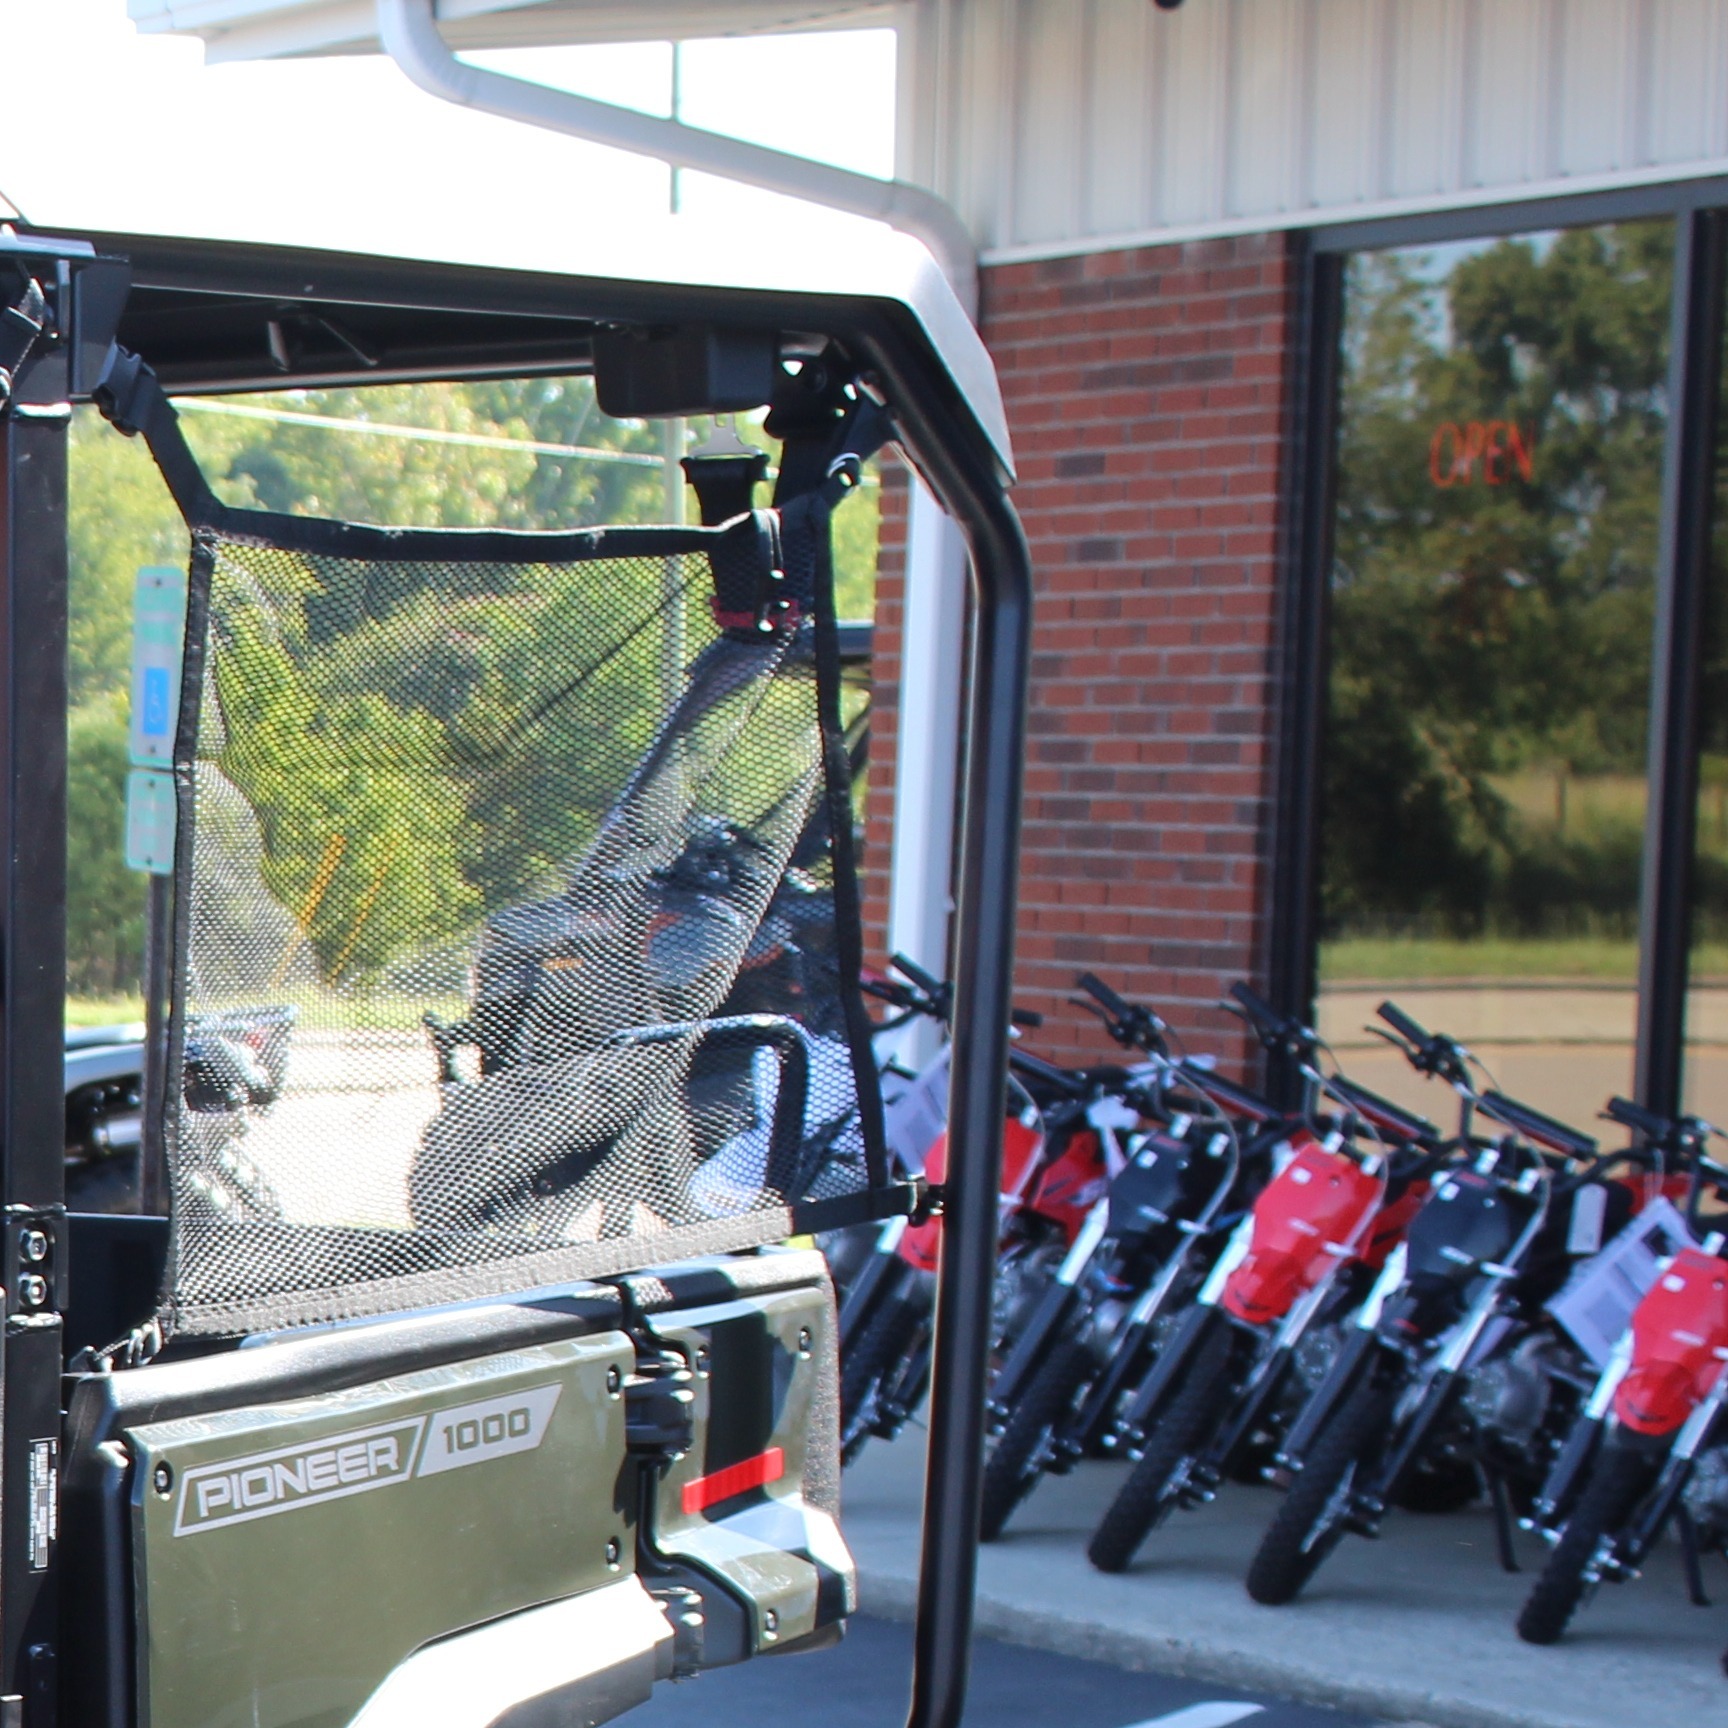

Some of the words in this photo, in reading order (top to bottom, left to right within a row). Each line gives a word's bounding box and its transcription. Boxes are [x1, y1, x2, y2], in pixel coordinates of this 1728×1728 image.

[1430, 421, 1536, 488] OPEN
[195, 1434, 399, 1519] PIONEER
[441, 1406, 532, 1455] 1000
